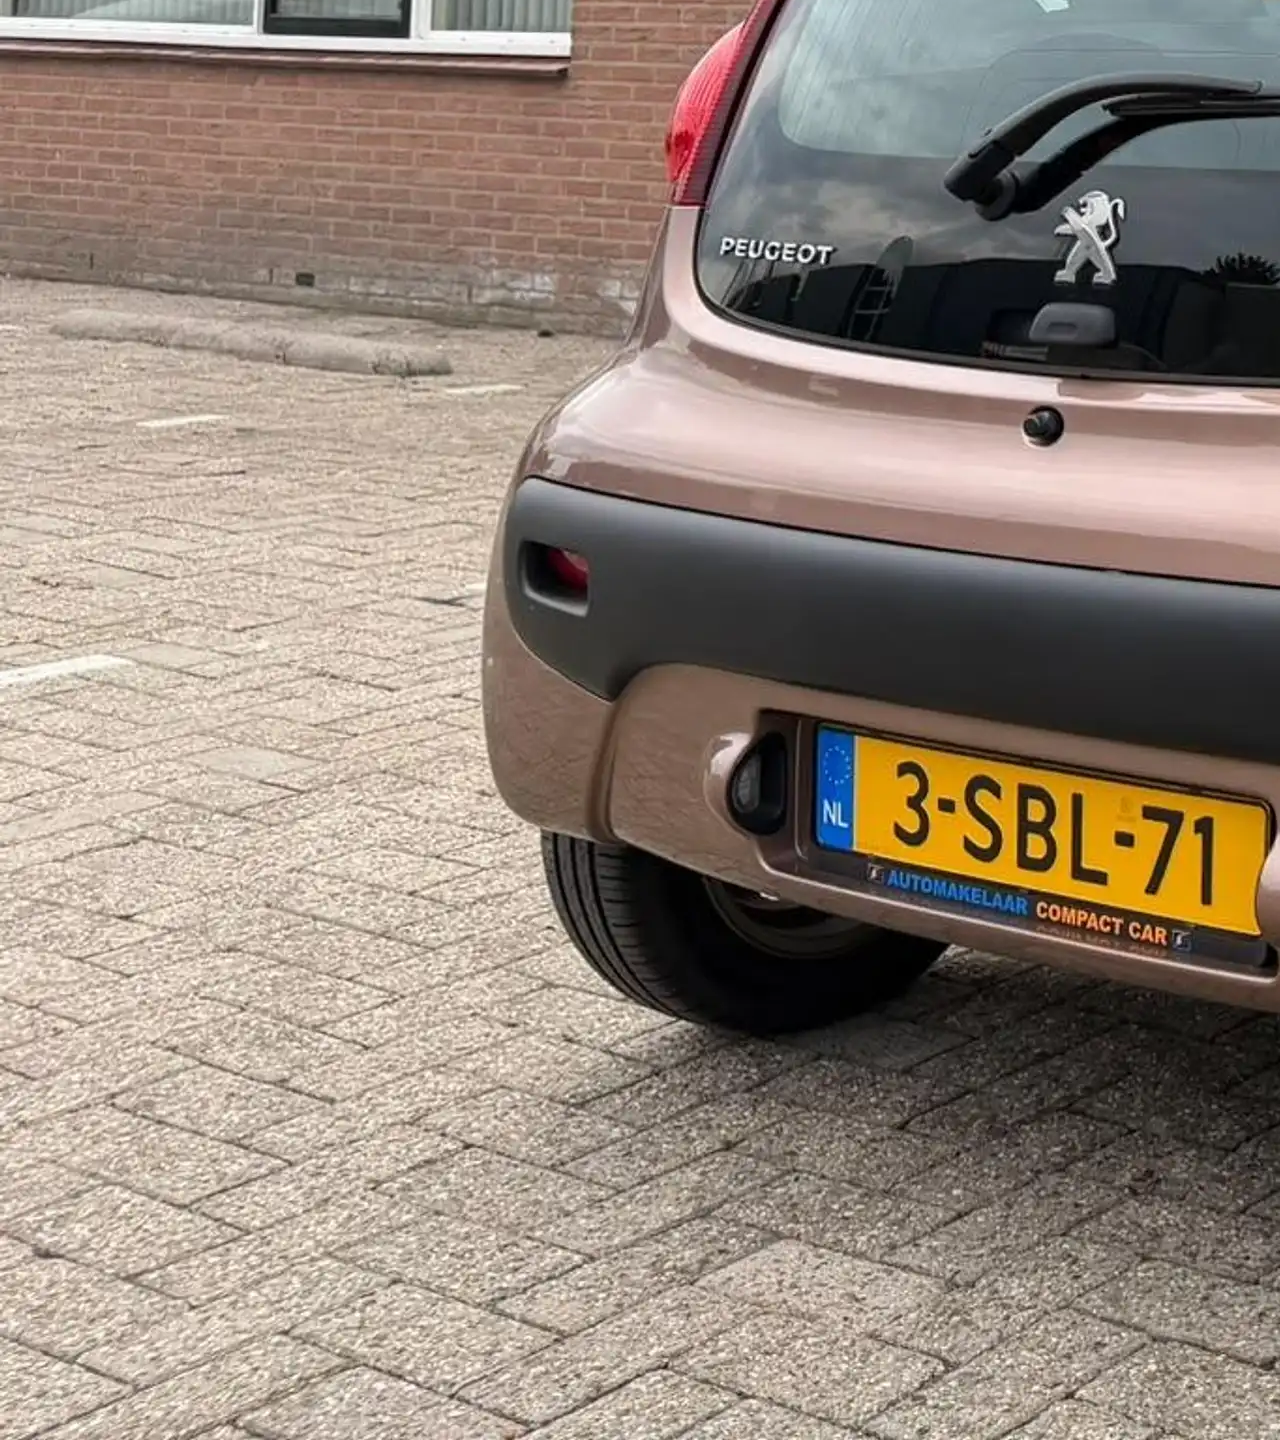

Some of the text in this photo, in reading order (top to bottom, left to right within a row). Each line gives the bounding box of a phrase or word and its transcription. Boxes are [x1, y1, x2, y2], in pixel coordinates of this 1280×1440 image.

[719, 236, 836, 266] PEUGEOT
[822, 799, 849, 830] NL
[894, 761, 1214, 907] 3-SBL-71
[887, 868, 1029, 917] AUTOMAKELAAR
[1035, 901, 1125, 939] COMPACT
[1128, 919, 1168, 948] CAR
